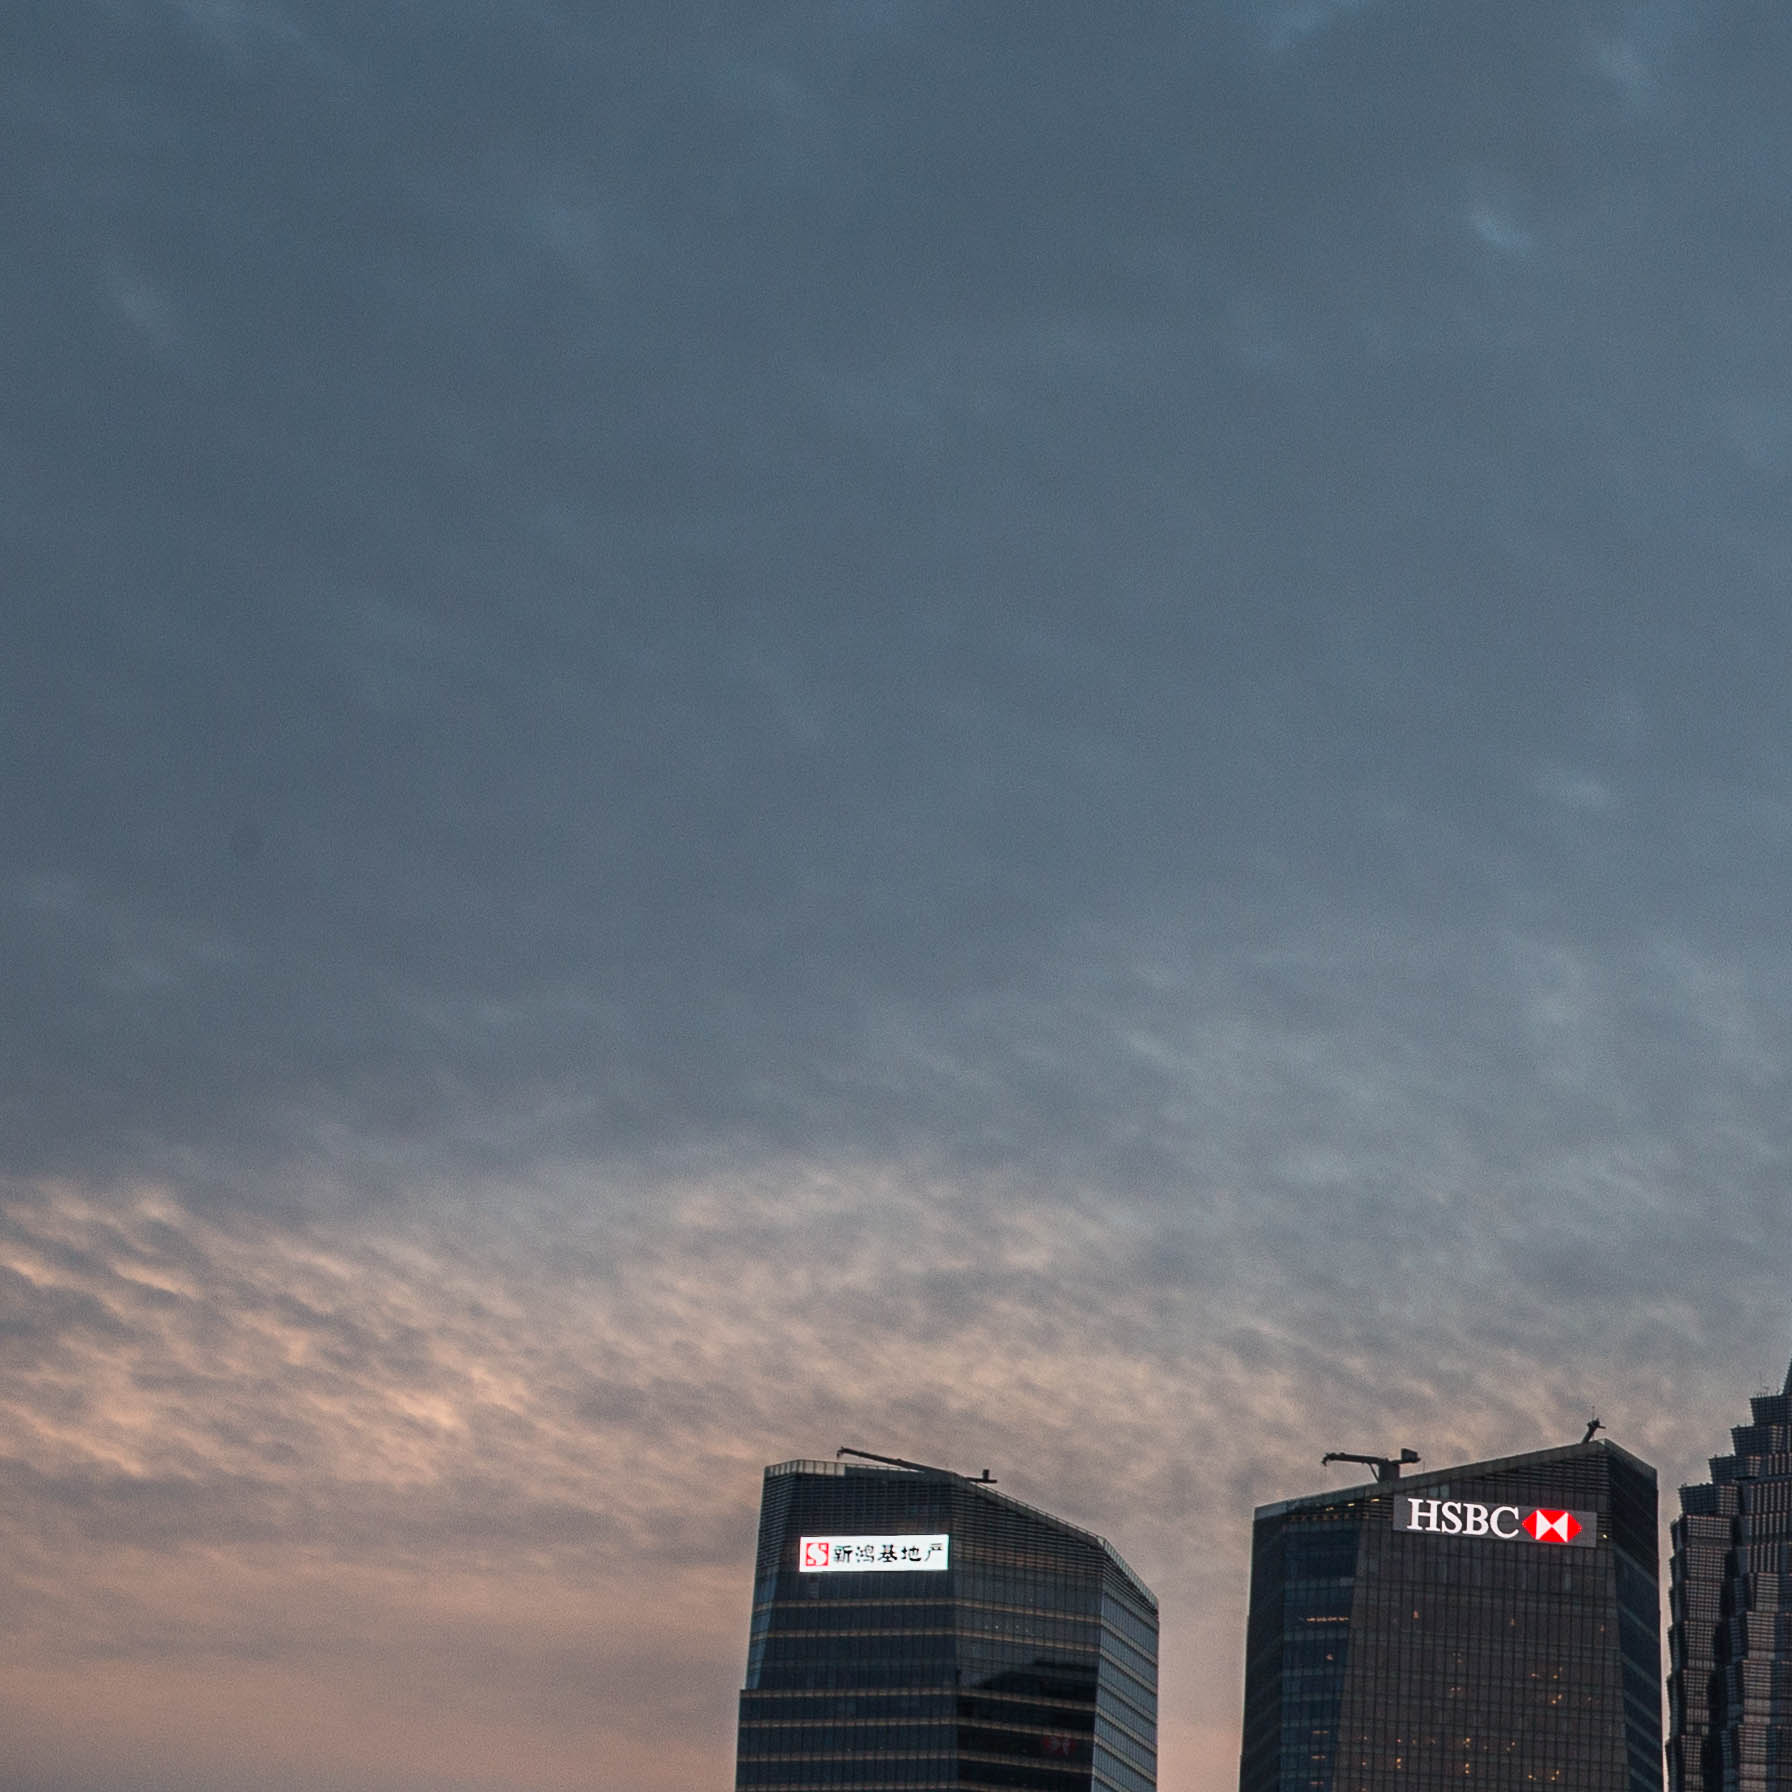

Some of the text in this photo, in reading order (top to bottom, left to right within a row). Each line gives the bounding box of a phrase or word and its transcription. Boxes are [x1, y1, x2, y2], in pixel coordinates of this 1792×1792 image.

[1407, 1497, 1520, 1539] HSBC
[833, 1542, 944, 1564] 新鸿基地产
